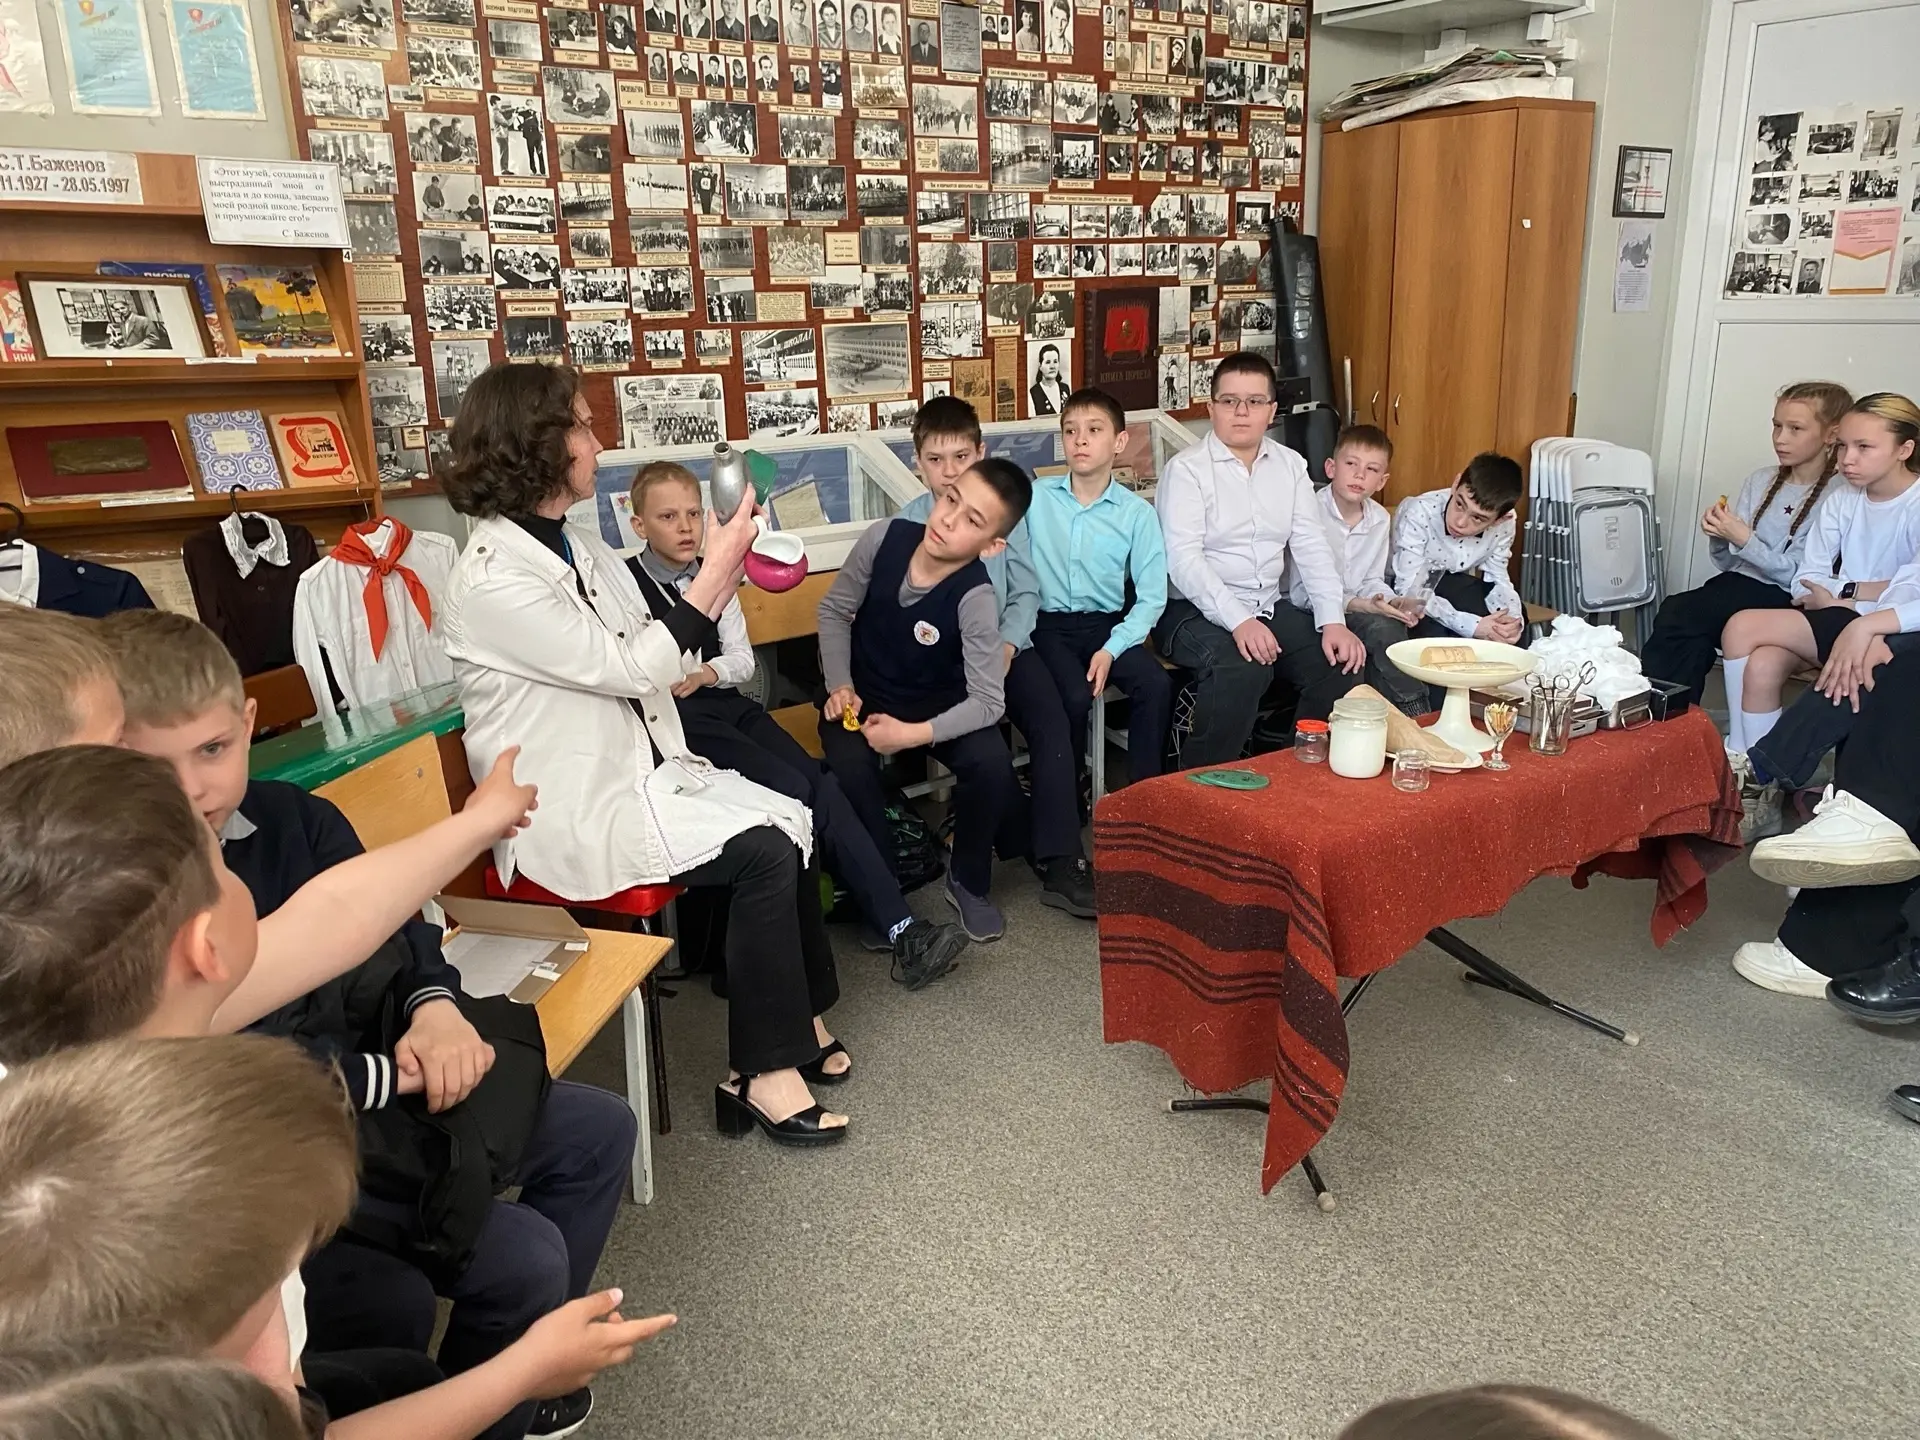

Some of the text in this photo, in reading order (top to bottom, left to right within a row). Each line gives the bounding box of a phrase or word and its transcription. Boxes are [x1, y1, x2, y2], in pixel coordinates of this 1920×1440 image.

[0, 153, 106, 172] С.Т.Баженов
[214, 167, 240, 177] «Этот
[243, 168, 270, 178] музей,
[272, 171, 317, 180] созданный
[61, 176, 129, 193] 28.05.1997
[209, 180, 273, 189] выстраданный
[282, 182, 304, 190] мной
[211, 191, 240, 199] начала
[263, 193, 291, 201] конца,
[237, 203, 269, 212] родной
[271, 204, 300, 212] школе.
[302, 203, 338, 214] Берегите
[223, 213, 287, 222] приумножайте
[282, 229, 330, 239] С. Баженов
[344, 251, 351, 261] 4
